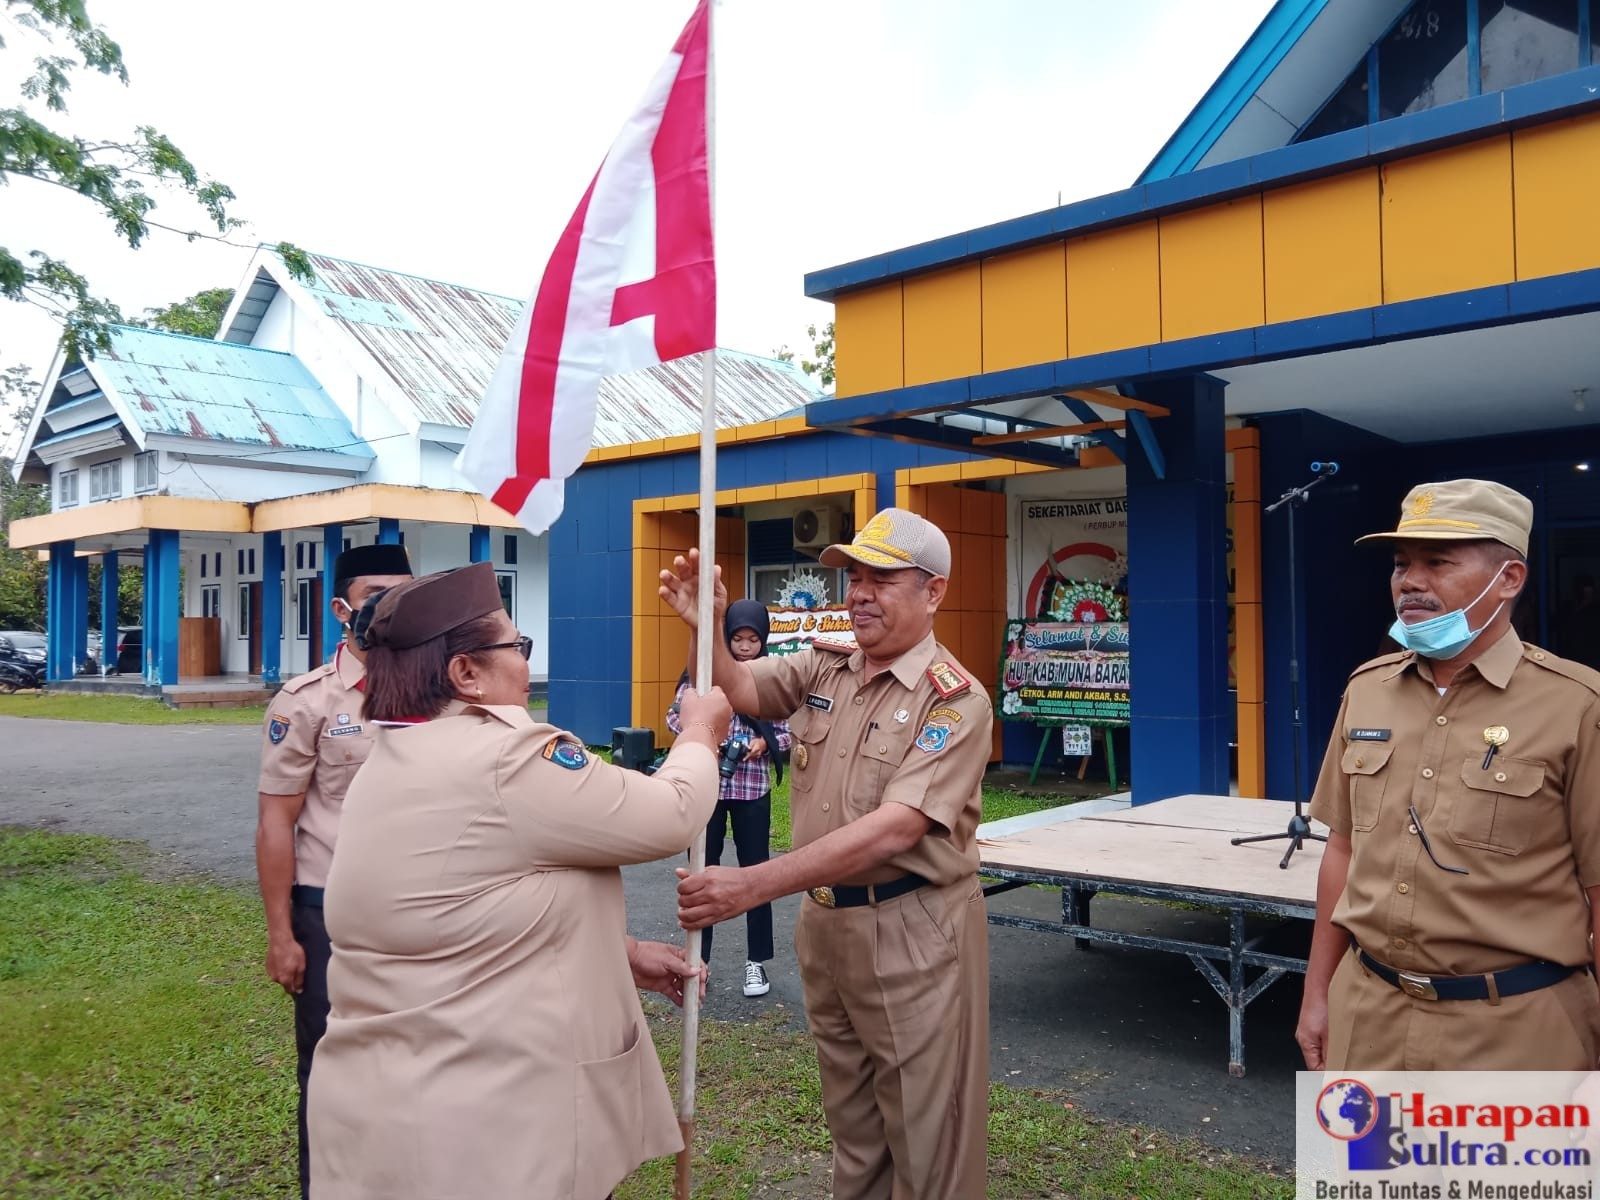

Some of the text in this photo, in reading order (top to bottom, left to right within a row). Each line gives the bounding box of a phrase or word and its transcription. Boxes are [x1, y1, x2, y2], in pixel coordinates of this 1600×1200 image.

[1028, 503, 1101, 518] SEKERTARIAT
[802, 614, 818, 633] &
[1024, 626, 1085, 648] Selamat
[1090, 624, 1101, 641] &
[1008, 662, 1031, 681] HUT
[1019, 688, 1046, 698] LETKOL
[1047, 689, 1064, 699] ARM
[1064, 689, 1083, 700] ANDI
